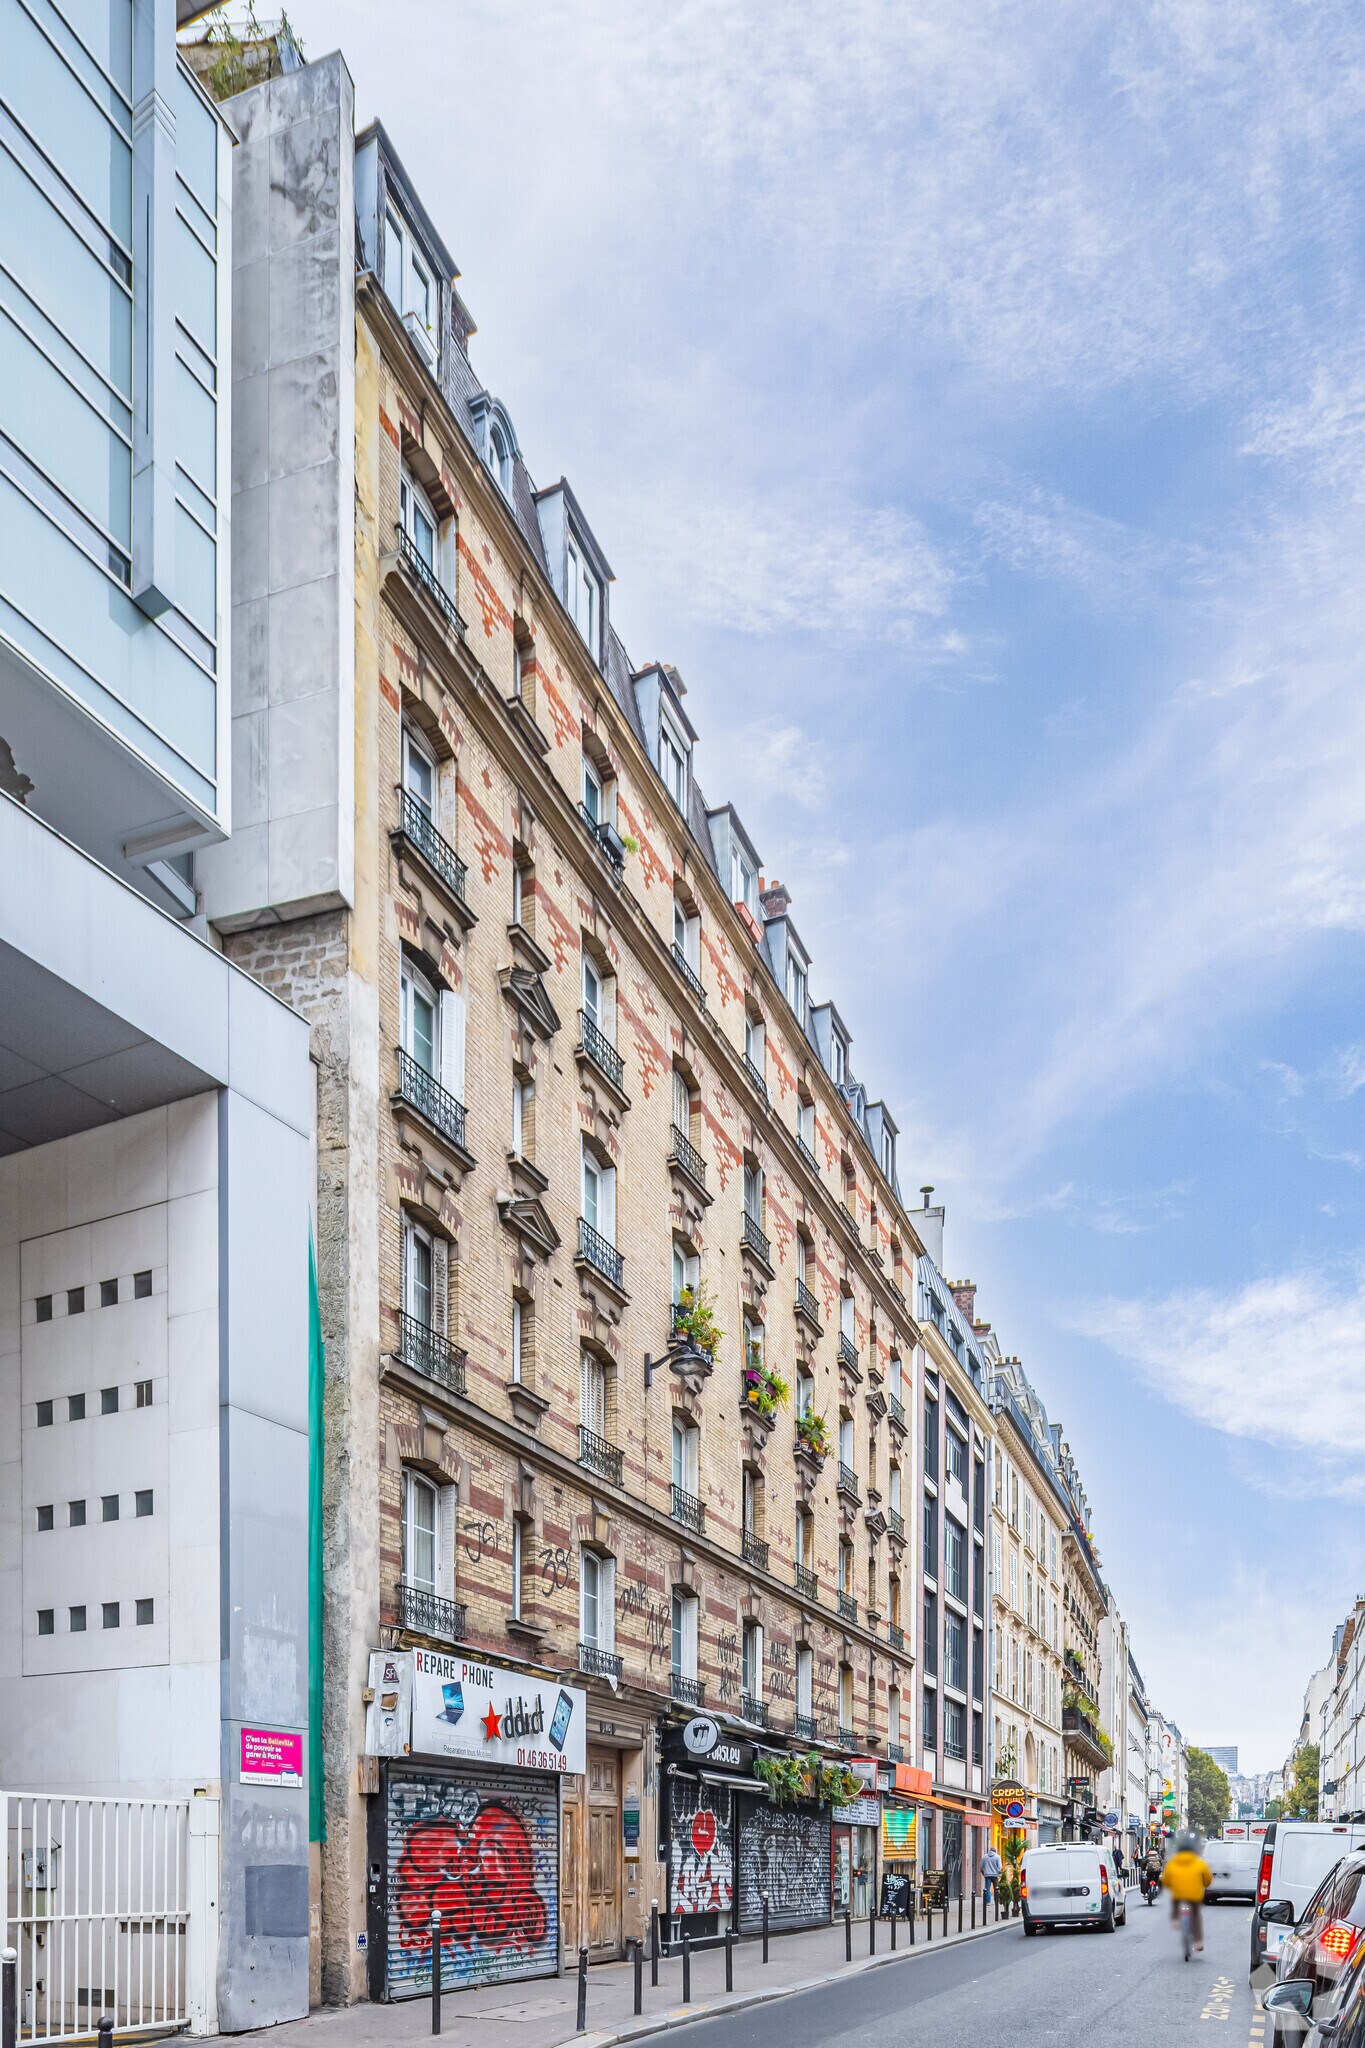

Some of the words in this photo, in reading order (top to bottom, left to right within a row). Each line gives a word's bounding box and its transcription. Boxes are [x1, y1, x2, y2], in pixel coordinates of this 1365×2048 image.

[416, 1651, 456, 1680] REPARE
[462, 1663, 494, 1689] PHONE
[267, 1737, 294, 1747] Belleville
[245, 1751, 261, 1759] garer
[443, 1744, 466, 1755] Réparation
[517, 1748, 525, 1765] 01
[527, 1750, 537, 1766] 46
[538, 1751, 547, 1768] 36
